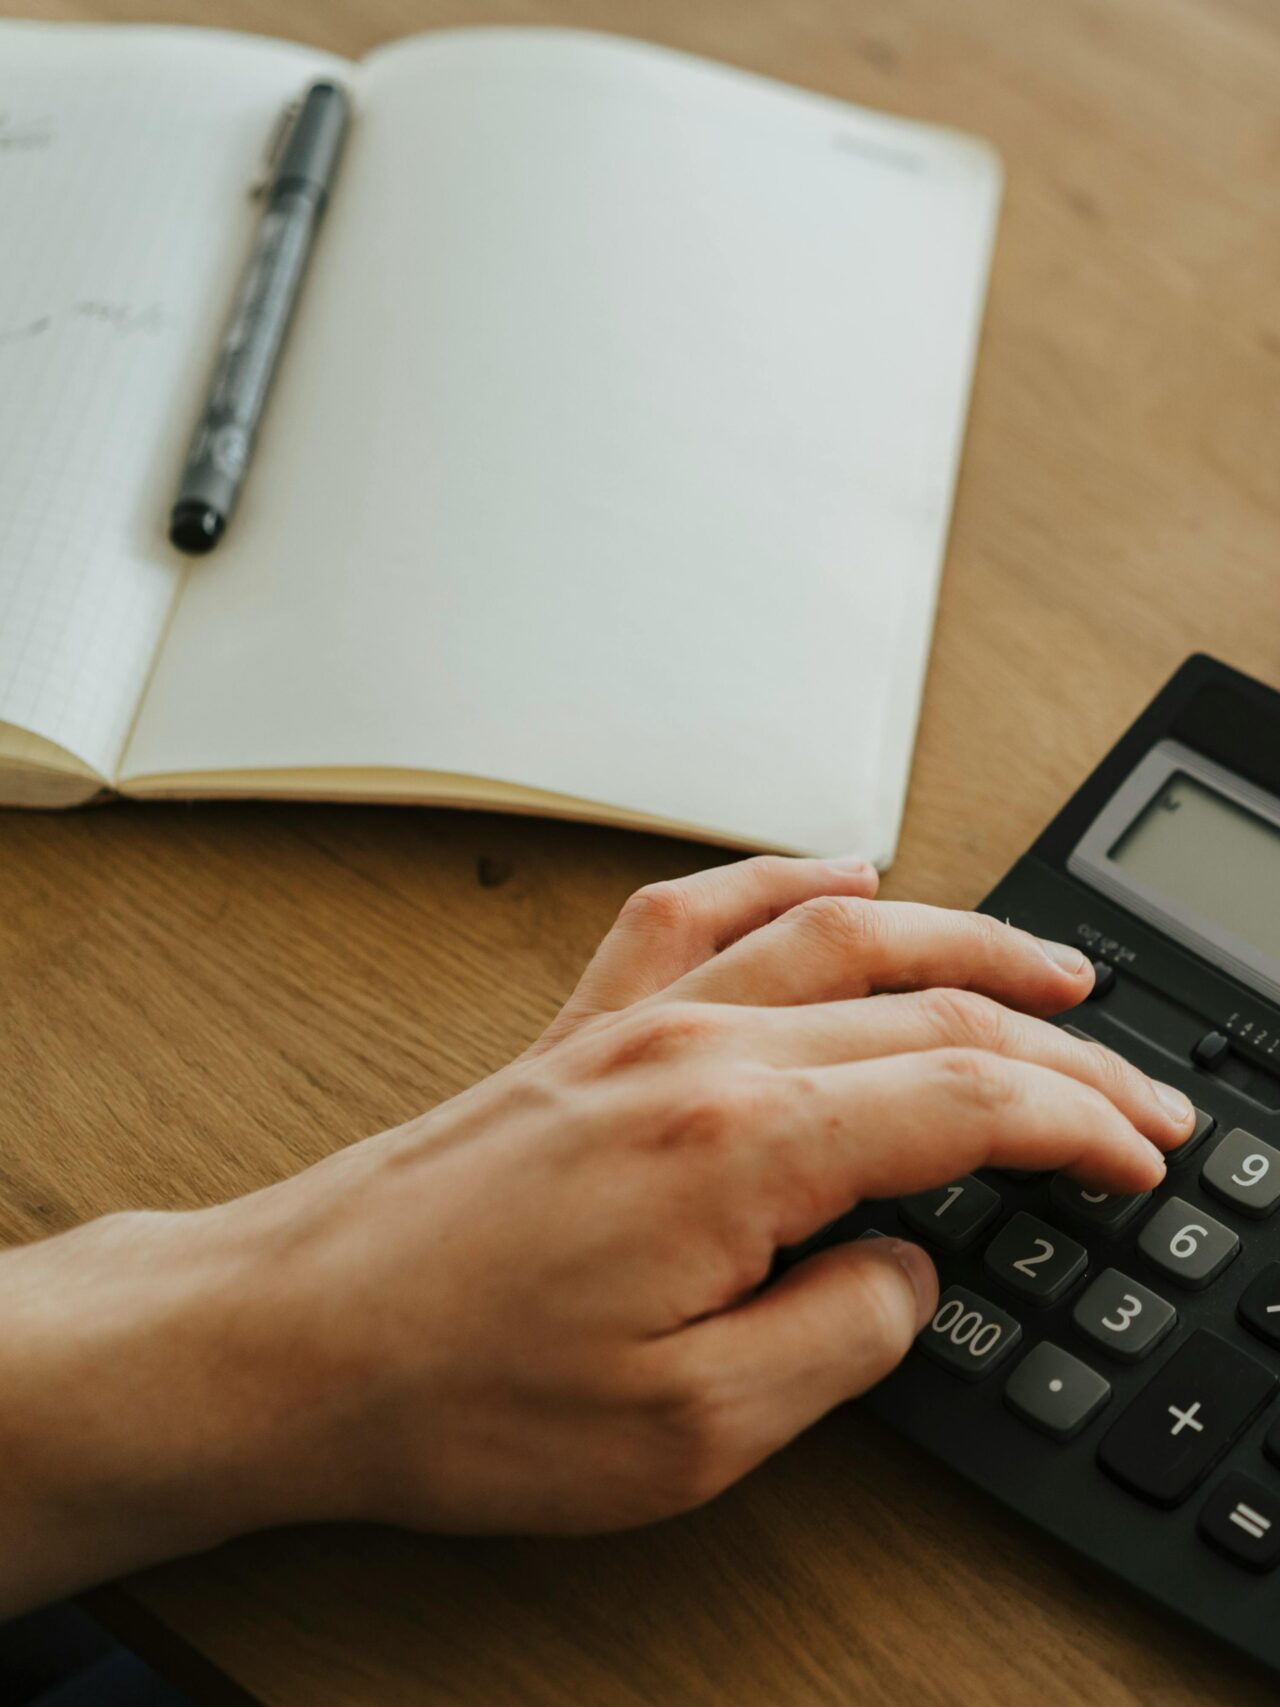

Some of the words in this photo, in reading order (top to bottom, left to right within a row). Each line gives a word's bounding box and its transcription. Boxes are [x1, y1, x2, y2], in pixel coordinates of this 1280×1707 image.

[1231, 1153, 1270, 1188] 9
[934, 1186, 965, 1217] 1
[1013, 1238, 1055, 1279] 2
[1169, 1224, 1209, 1259] 6
[931, 1300, 1002, 1357] 000
[1101, 1294, 1143, 1332] 3
